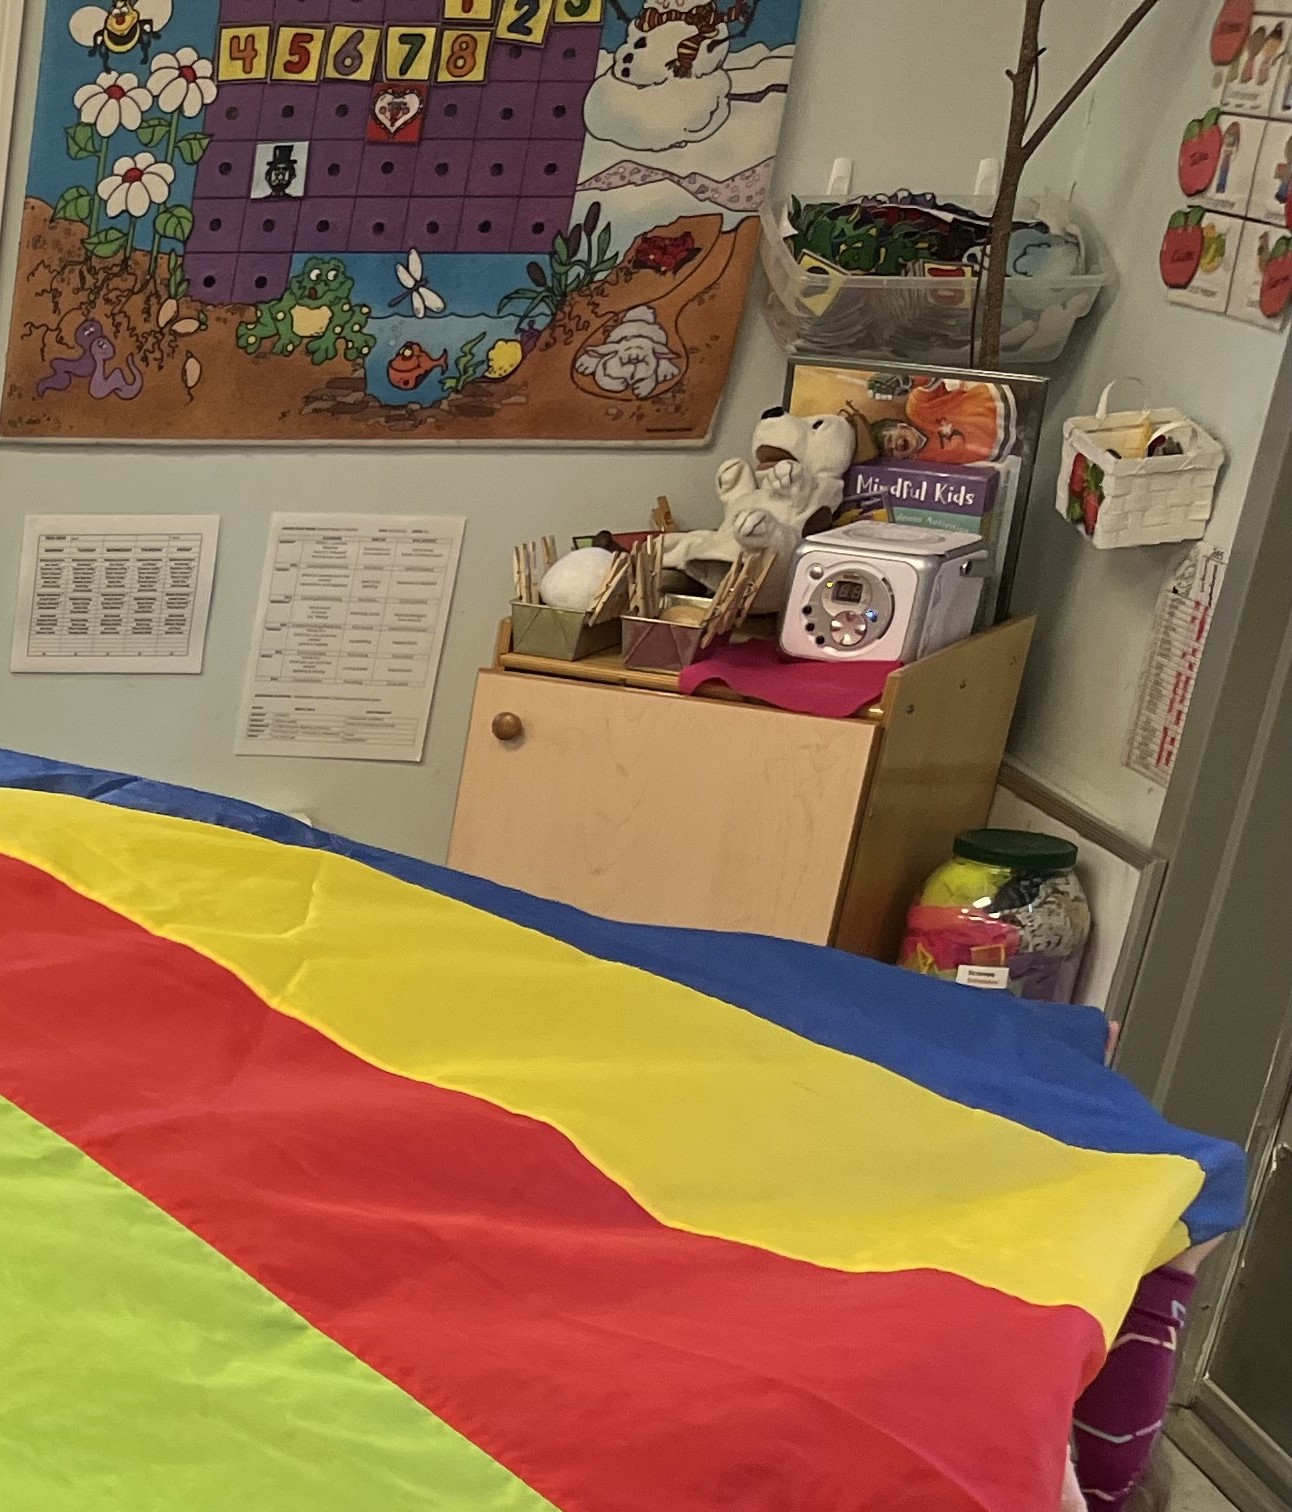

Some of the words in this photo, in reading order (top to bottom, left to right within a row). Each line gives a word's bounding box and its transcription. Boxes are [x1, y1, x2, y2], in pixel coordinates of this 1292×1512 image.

[507, 0, 540, 36] 2
[229, 34, 258, 75] 4
[283, 33, 314, 75] 5
[333, 30, 365, 76] 6
[398, 33, 427, 76] 7
[446, 33, 478, 77] 8
[934, 483, 975, 507] Kids
